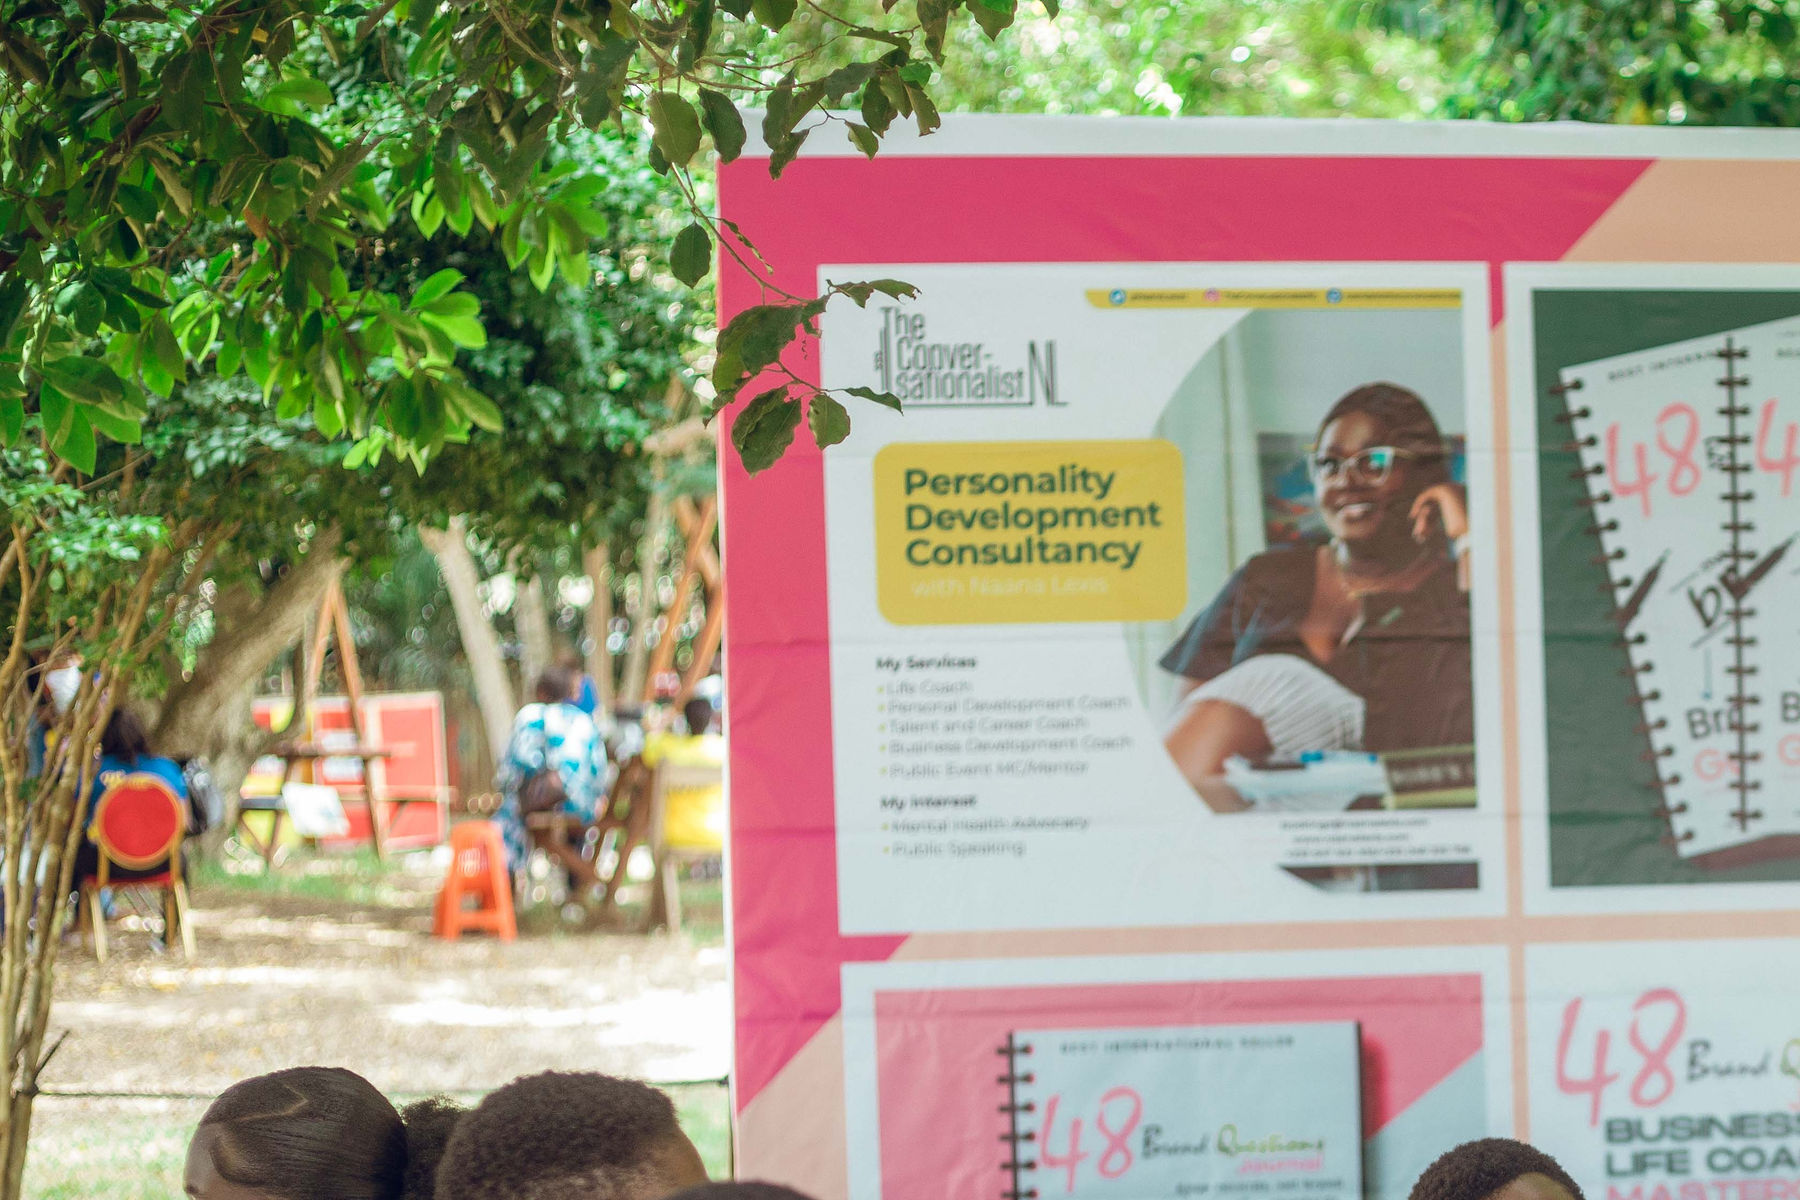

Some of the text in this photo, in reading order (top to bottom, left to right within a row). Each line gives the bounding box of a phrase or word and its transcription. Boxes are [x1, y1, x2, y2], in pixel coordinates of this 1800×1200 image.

[880, 306, 925, 340] The
[1605, 402, 1700, 518] 48
[905, 464, 1115, 499] Personality
[905, 502, 1162, 535] Development
[905, 537, 1141, 569] Consultancy
[876, 656, 977, 672] My Services
[880, 797, 905, 811] My
[1556, 987, 1687, 1129] 48
[1687, 1038, 1772, 1083] Brand
[1041, 1085, 1143, 1193] 48
[1142, 1124, 1211, 1160] Brand
[1606, 1148, 1692, 1178] LIFE
